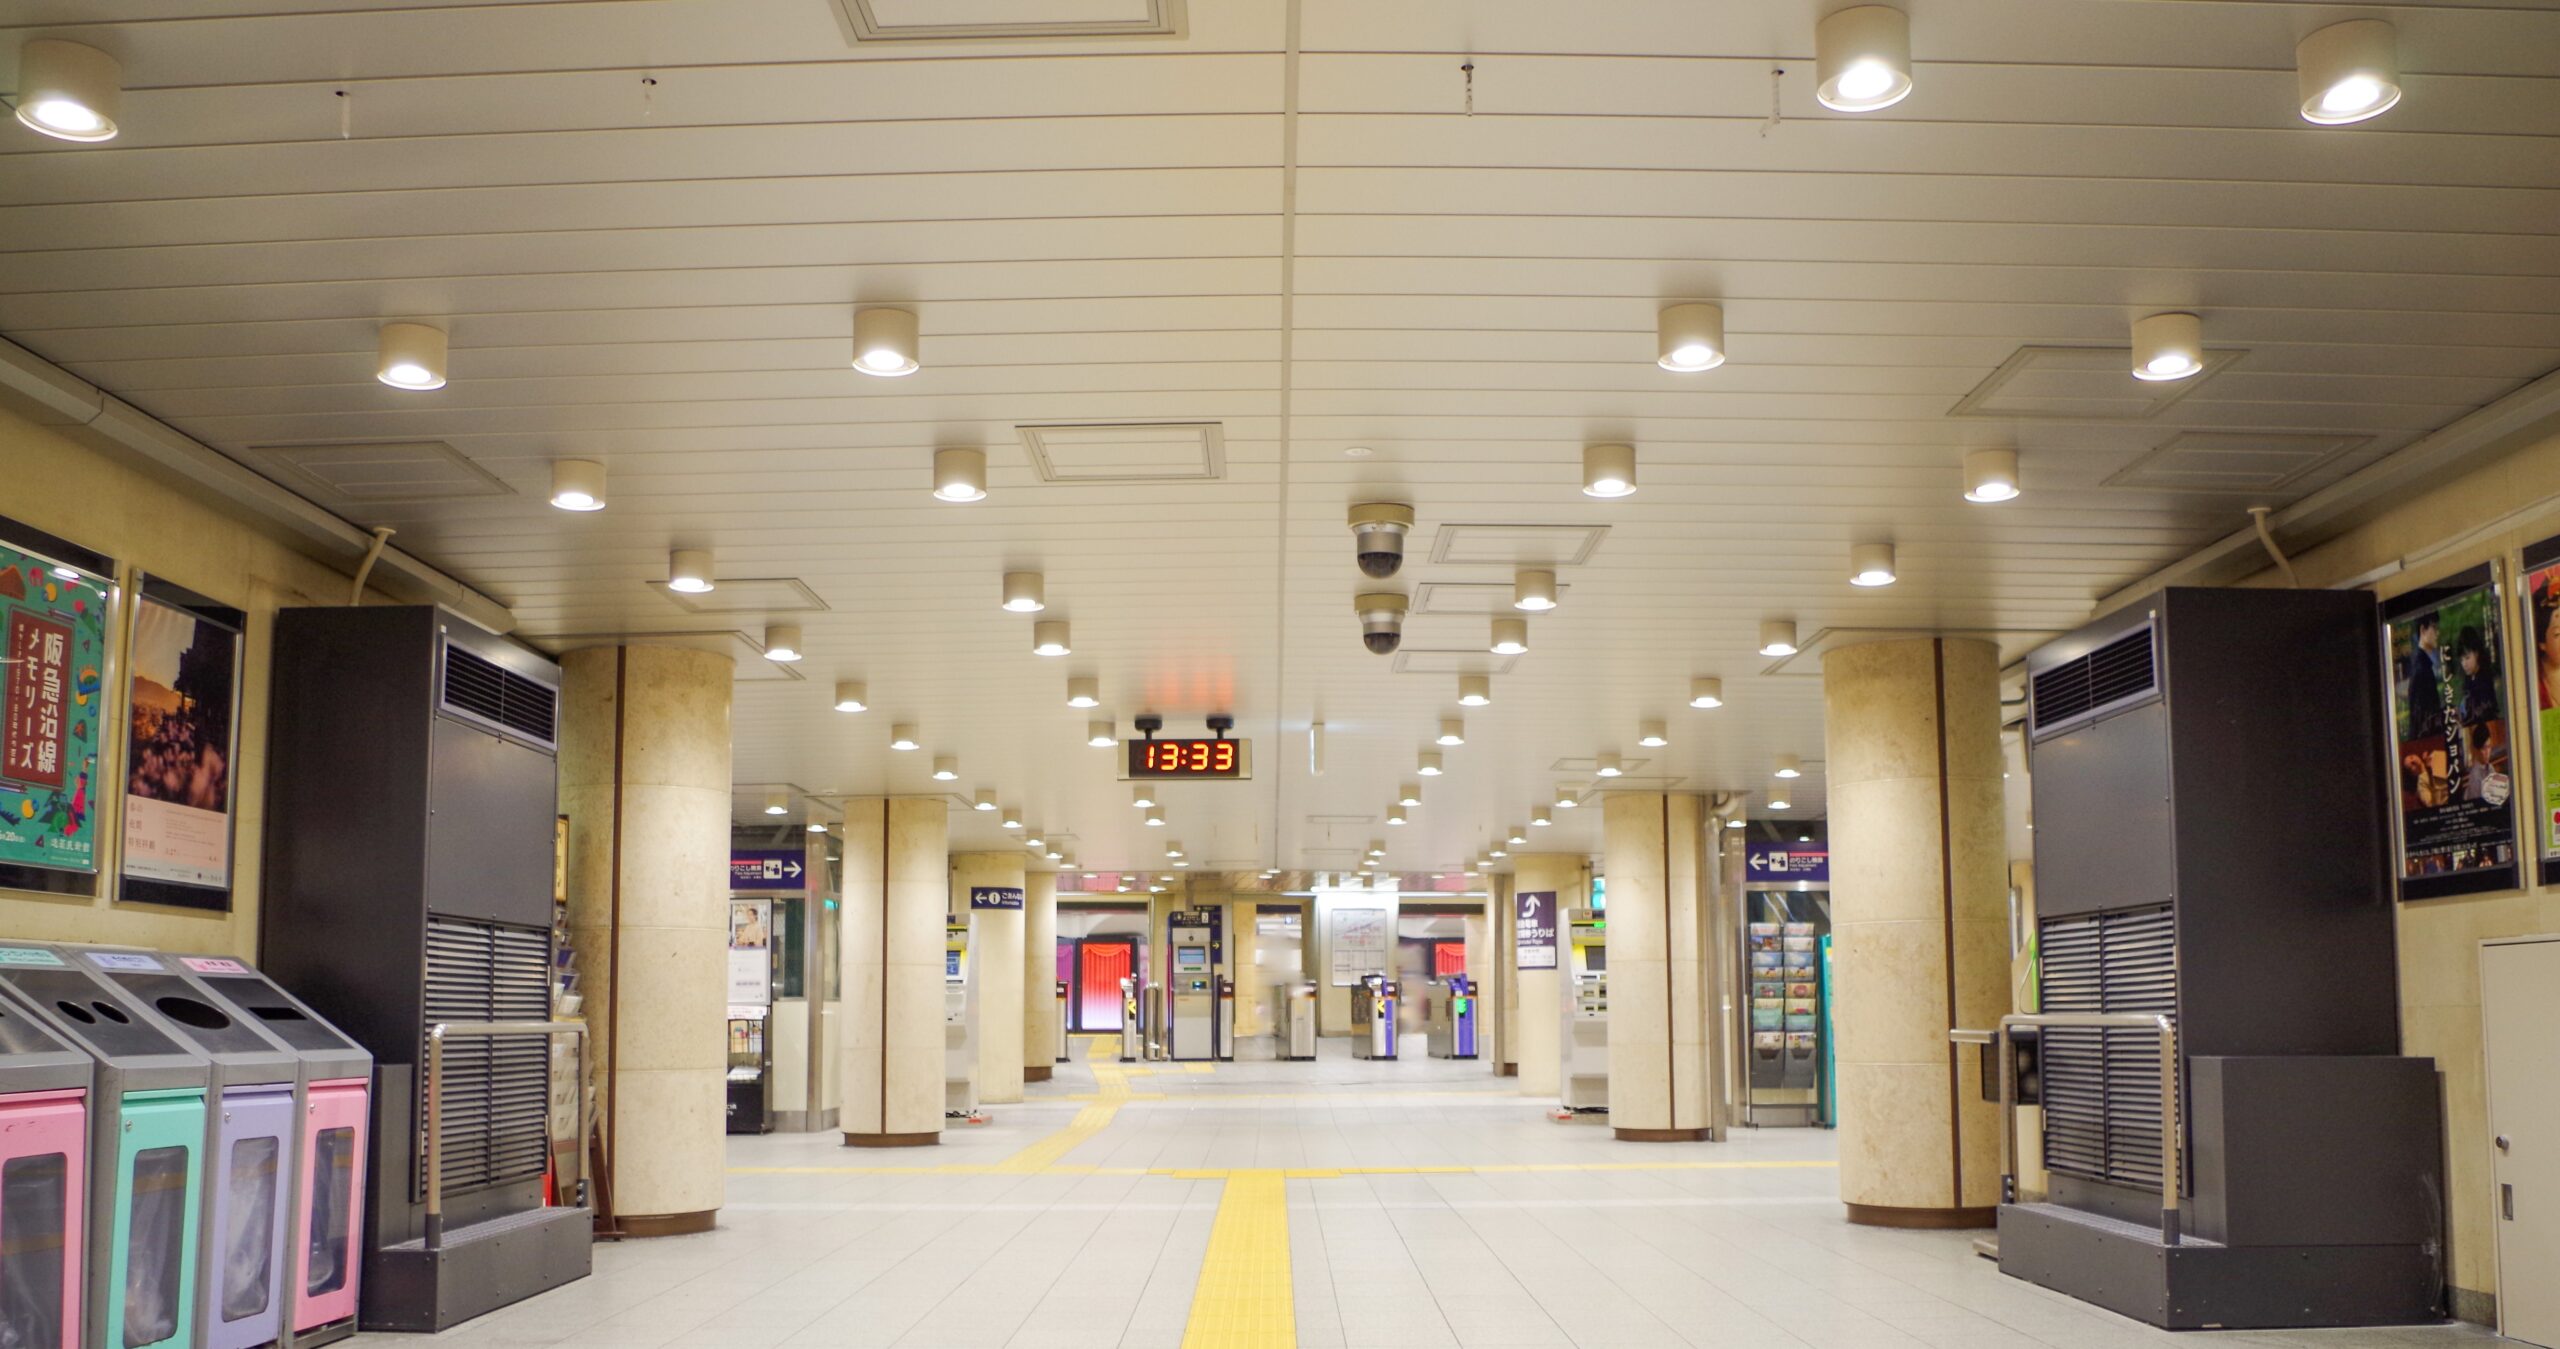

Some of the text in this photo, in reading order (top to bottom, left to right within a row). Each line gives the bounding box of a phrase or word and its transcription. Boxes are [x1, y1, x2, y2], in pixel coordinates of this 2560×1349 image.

[20, 628, 40, 769] メモリーズ
[37, 632, 64, 774] 阪急沿線
[1147, 743, 1233, 770] 13:33
[2440, 645, 2461, 794] にしきたショパン
